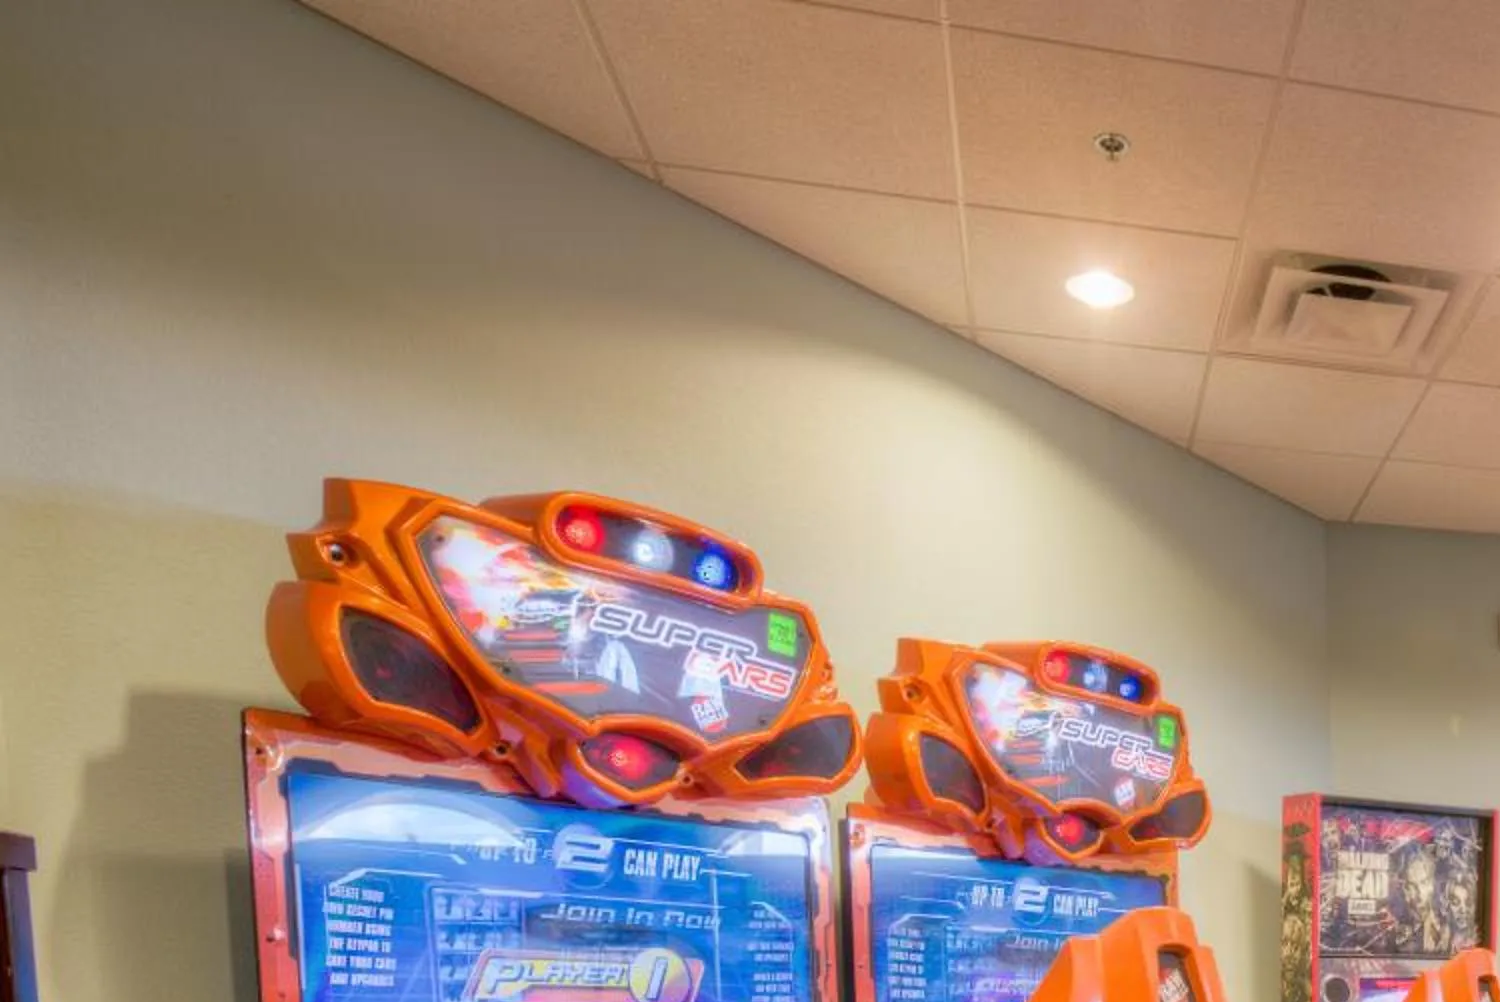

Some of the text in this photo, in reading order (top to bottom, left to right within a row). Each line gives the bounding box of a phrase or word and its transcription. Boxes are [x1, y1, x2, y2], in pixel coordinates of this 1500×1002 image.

[590, 604, 758, 662] SUPER
[684, 650, 797, 701] CARS
[1061, 718, 1152, 752] SUPER
[556, 833, 615, 873] 2
[623, 847, 658, 878] CAN
[661, 852, 701, 882] PLAY
[1015, 883, 1049, 913] 2
[1075, 895, 1100, 917] PLAY
[1336, 870, 1389, 899] DEAD
[539, 903, 616, 924] Join
[486, 957, 626, 994] PLAYER
